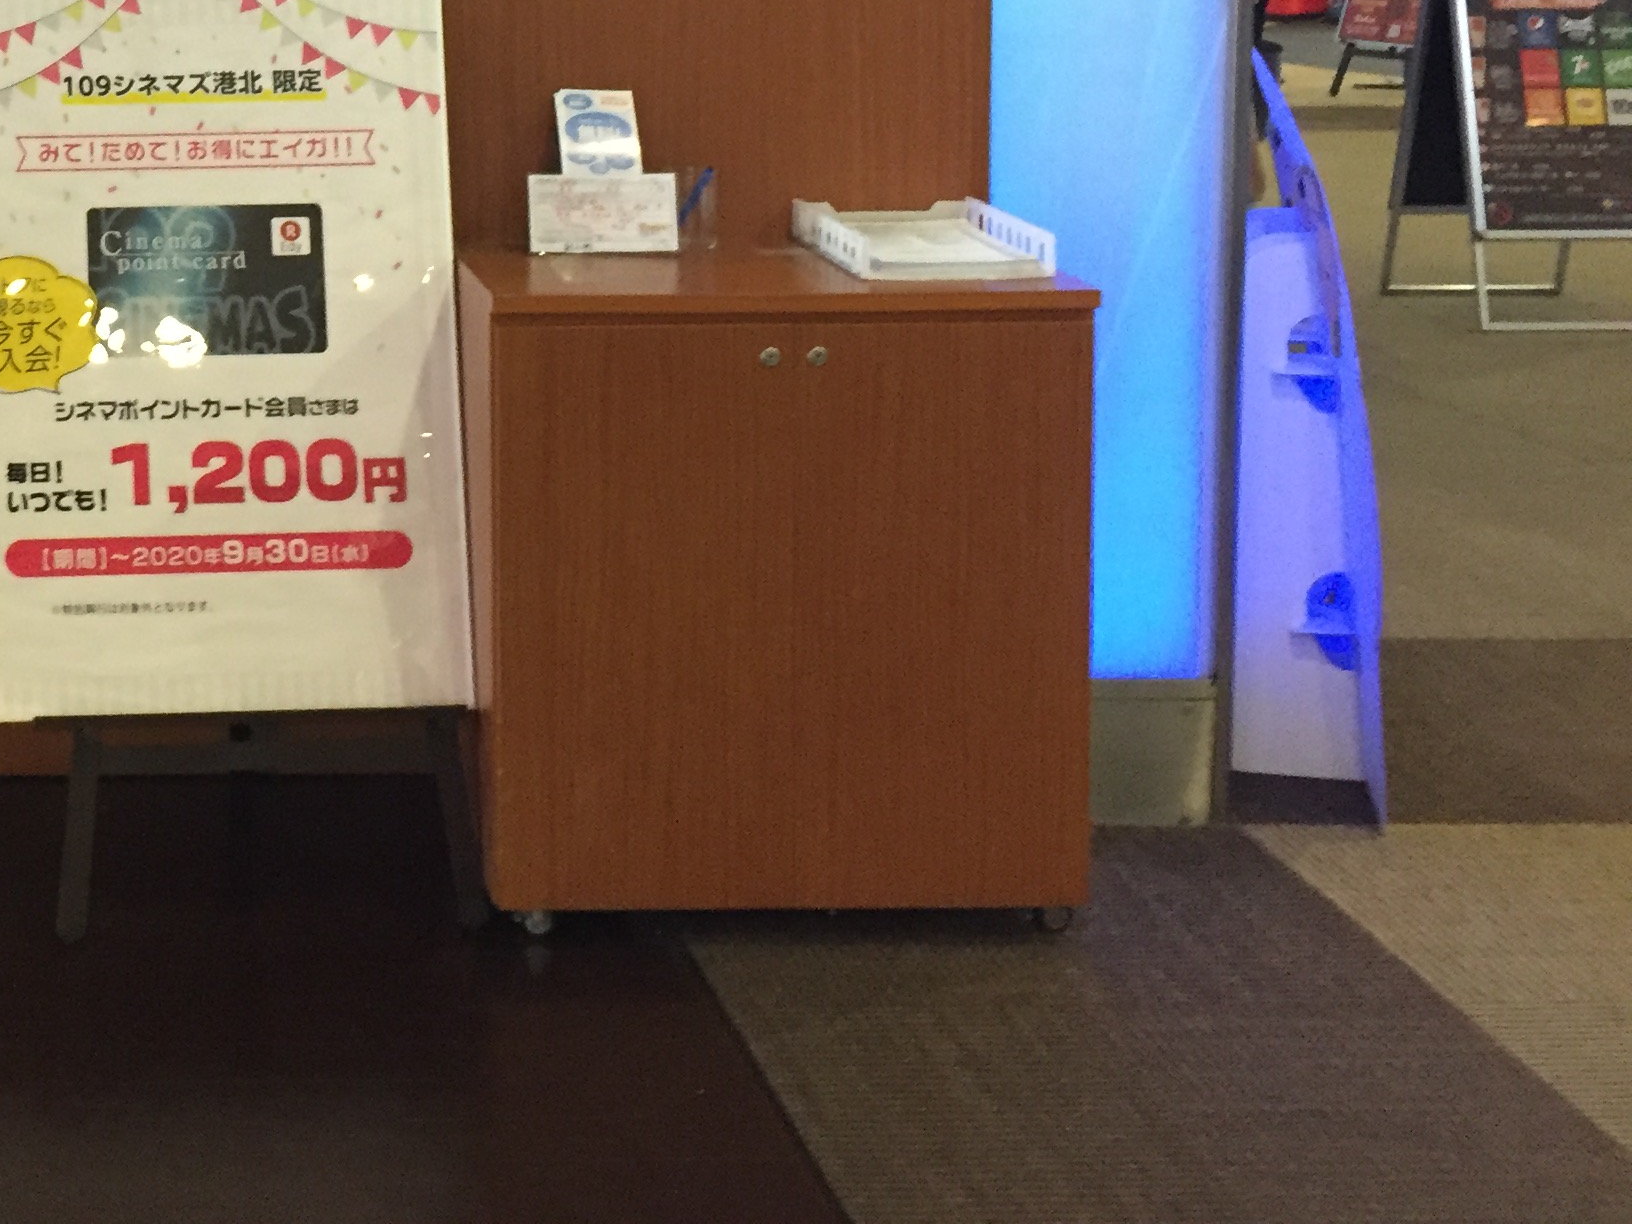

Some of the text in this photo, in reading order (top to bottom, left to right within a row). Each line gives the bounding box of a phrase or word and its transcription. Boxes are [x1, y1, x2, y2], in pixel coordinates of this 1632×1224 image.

[63, 69, 323, 98] 109シネマズ港北 限定
[99, 229, 203, 257] Cinema
[117, 250, 247, 274] point card
[54, 396, 359, 423] シネマポイントカード会員さまは
[5, 460, 65, 484] 毎日!
[111, 437, 407, 515] 1,200円
[7, 488, 108, 514] いつでも!
